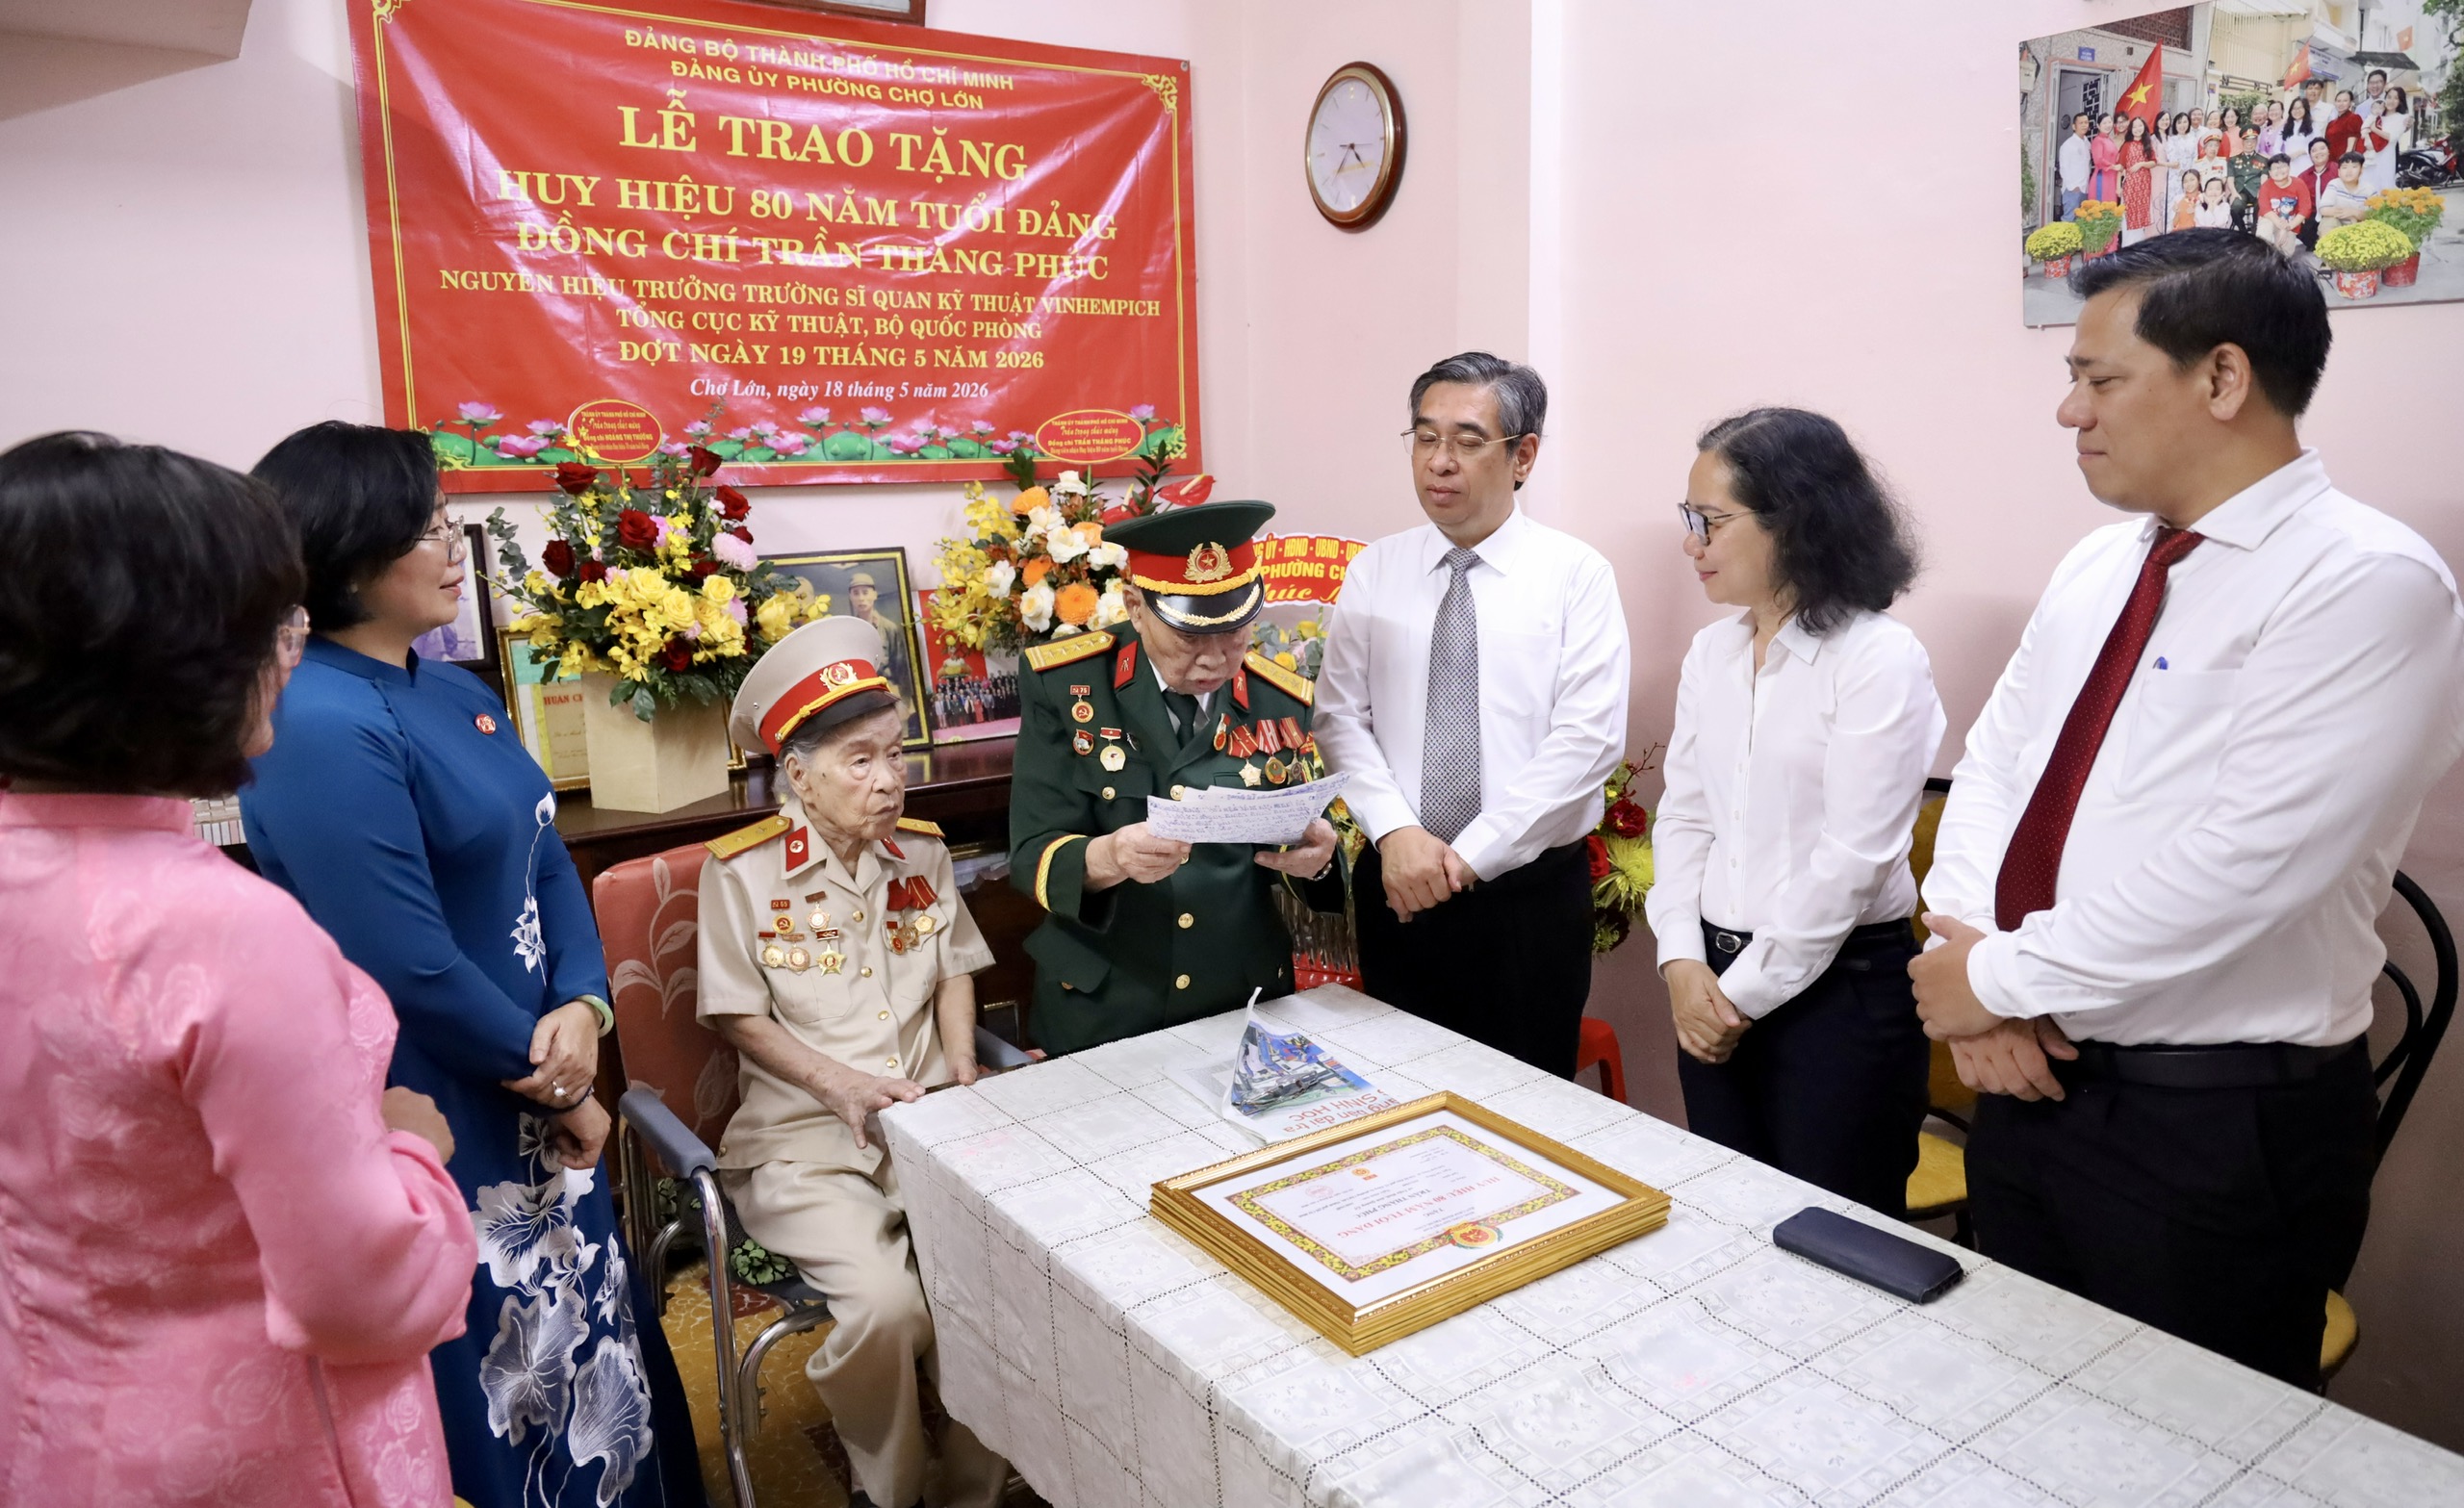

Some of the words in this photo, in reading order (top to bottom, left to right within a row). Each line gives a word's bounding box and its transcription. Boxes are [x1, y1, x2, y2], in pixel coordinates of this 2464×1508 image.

[625, 26, 696, 55] ĐẢNG
[705, 38, 738, 62] BỘ
[746, 44, 826, 68] THÀNH
[833, 53, 877, 76] PHỐ
[885, 57, 914, 80] HỒ
[922, 64, 957, 85] CHÍ
[963, 74, 1014, 90] MINH
[671, 57, 741, 84] ĐẢNG
[748, 64, 777, 88] ỦY
[787, 74, 882, 100] PHƯỜNG
[888, 87, 934, 108] CHỢ
[941, 89, 983, 110] LỚN
[617, 89, 697, 152] LỄ
[719, 115, 873, 166] TRAO
[889, 126, 1028, 183] TẶNG
[497, 169, 600, 205] HUY
[615, 174, 735, 220] HIỆU
[751, 190, 792, 220] 80
[806, 189, 897, 227] NĂM
[911, 192, 1007, 234] TUỔI
[1017, 200, 1116, 241] ĐẢNG
[514, 210, 647, 258] ĐỒNG
[662, 226, 739, 263] CHÍ
[753, 226, 862, 270] TRẦN
[1014, 248, 1108, 280] PHÚC
[440, 269, 552, 294] NGUYÊN
[562, 274, 625, 301] HIỆU
[632, 275, 735, 303] TRƯỞNG
[743, 281, 838, 307] TRƯỜNG
[846, 287, 866, 307] SĨ
[873, 292, 931, 312] QUAN
[937, 290, 963, 311] KỸ
[971, 292, 1036, 316] THUẬT
[1041, 296, 1160, 317] VINHEMPICH
[616, 302, 684, 330] TỔNG
[692, 313, 741, 335] CỤC
[750, 309, 779, 332] KỸ
[787, 314, 868, 338] THUẬT,
[875, 314, 904, 337] BỘ
[911, 316, 966, 339] QUỐC
[972, 317, 1041, 339] PHÒNG
[619, 341, 680, 368] ĐỢT
[690, 338, 770, 365] NGÀY
[780, 346, 806, 366] 19
[814, 342, 906, 367] THÁNG
[913, 349, 927, 367] 5
[934, 345, 988, 368] NĂM
[995, 350, 1044, 369] 2026
[690, 378, 728, 402] Chợ
[732, 379, 771, 399] Lớn,
[777, 381, 818, 401] ngày
[824, 382, 843, 397] 18
[847, 381, 895, 402] tháng
[899, 383, 910, 397] 5
[913, 382, 947, 398] năm
[951, 383, 988, 398] 2026
[1259, 558, 1324, 578] PHƯỜNG
[1315, 538, 1339, 559] UBND
[1264, 583, 1312, 601] húc
